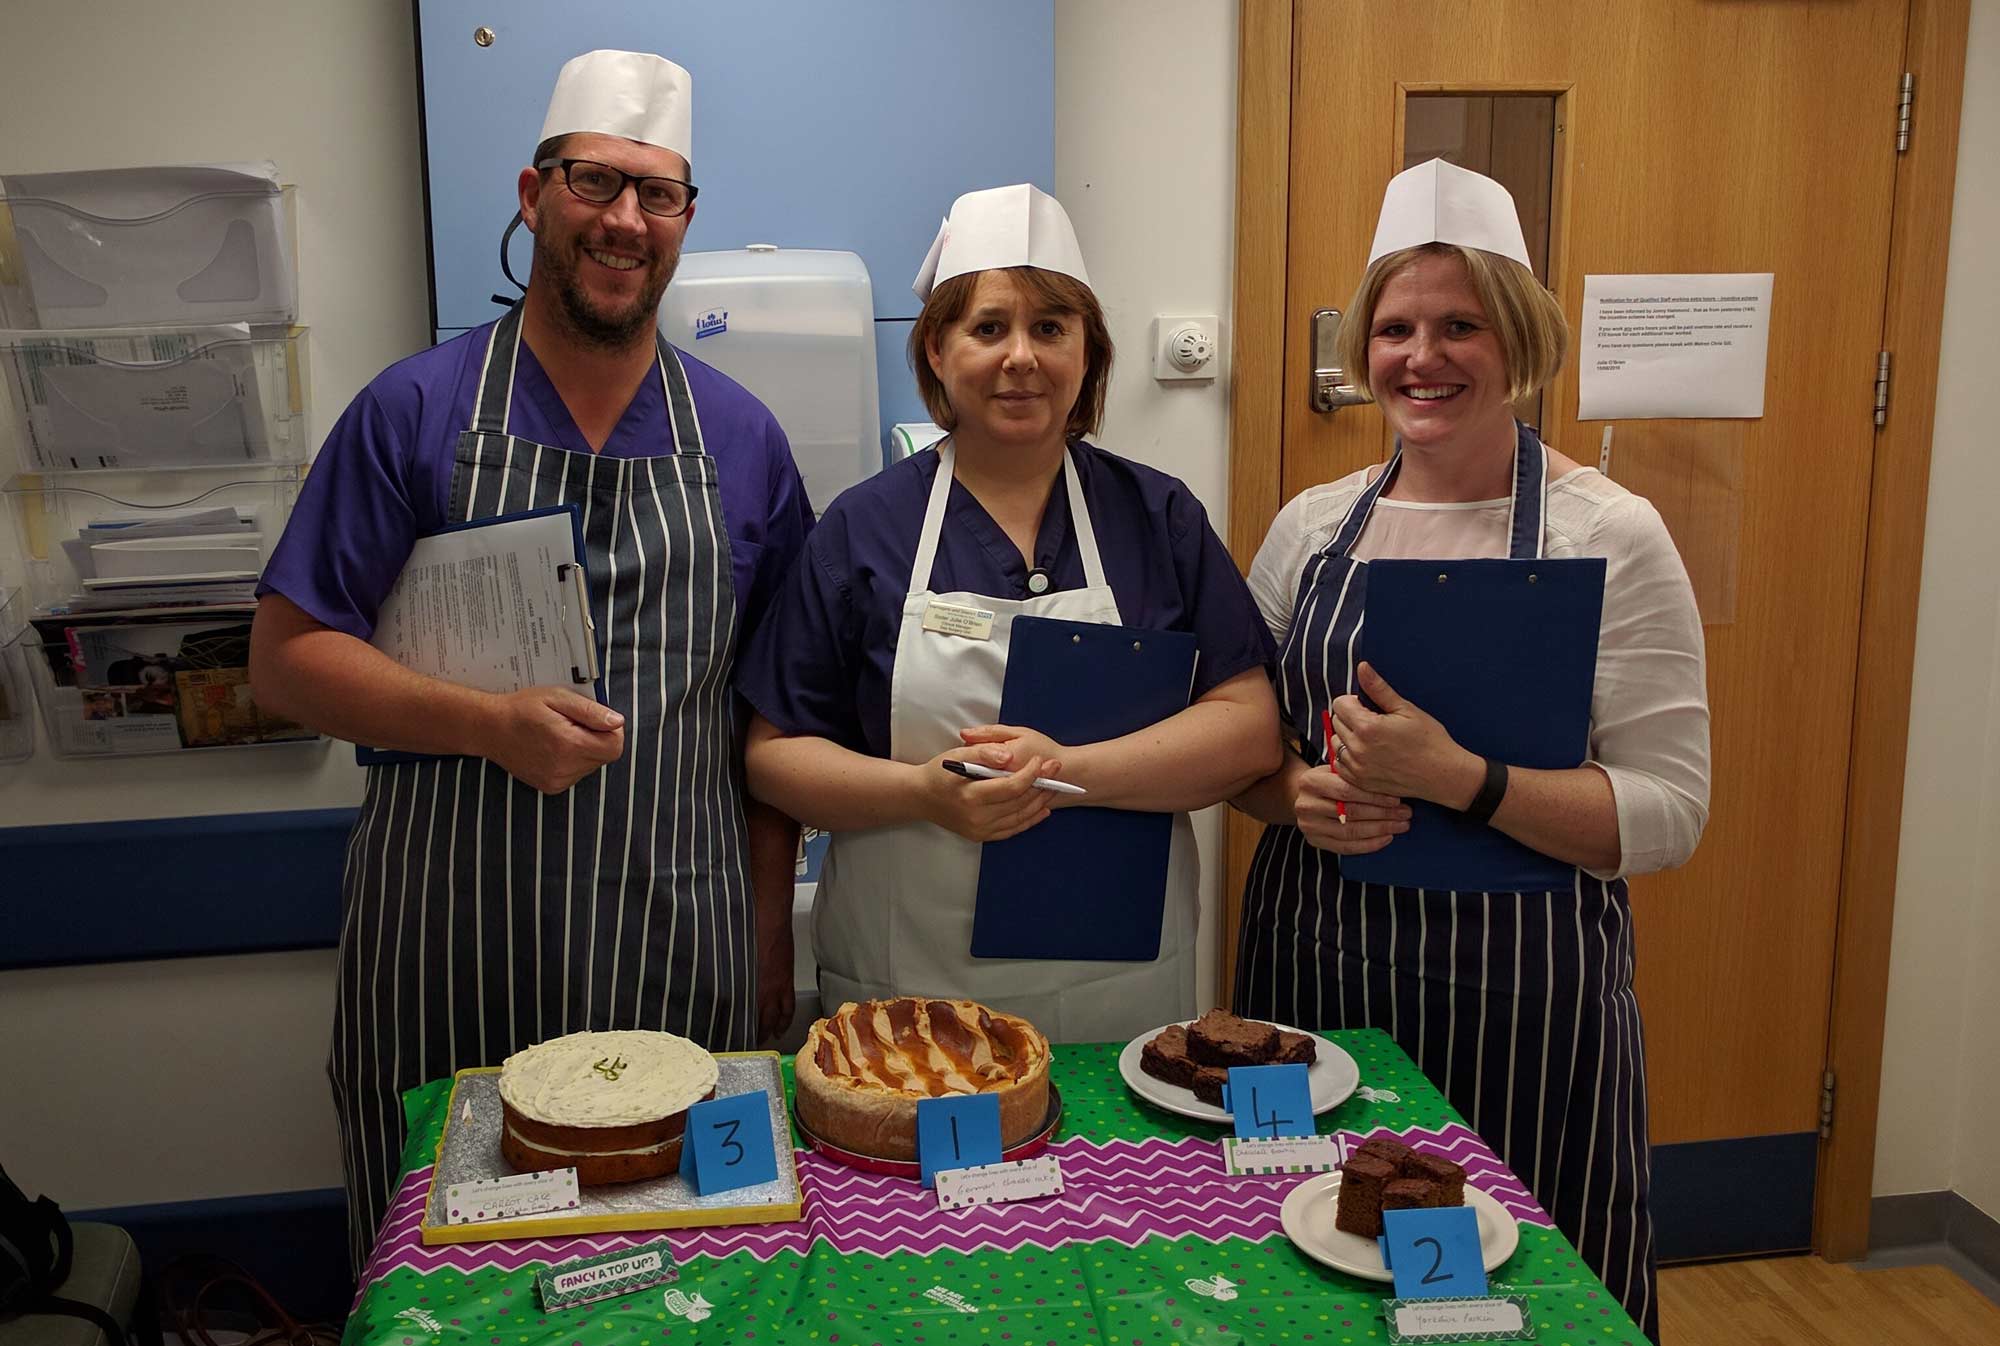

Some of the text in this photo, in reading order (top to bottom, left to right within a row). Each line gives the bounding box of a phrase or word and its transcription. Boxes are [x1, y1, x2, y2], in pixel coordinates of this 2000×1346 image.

[1252, 1087, 1294, 1137] 4
[713, 1120, 744, 1166] 3
[483, 1192, 551, 1210] CARROT CAKE
[560, 1256, 654, 1288] FANCY A TOP UP?
[1413, 1237, 1454, 1284] 2
